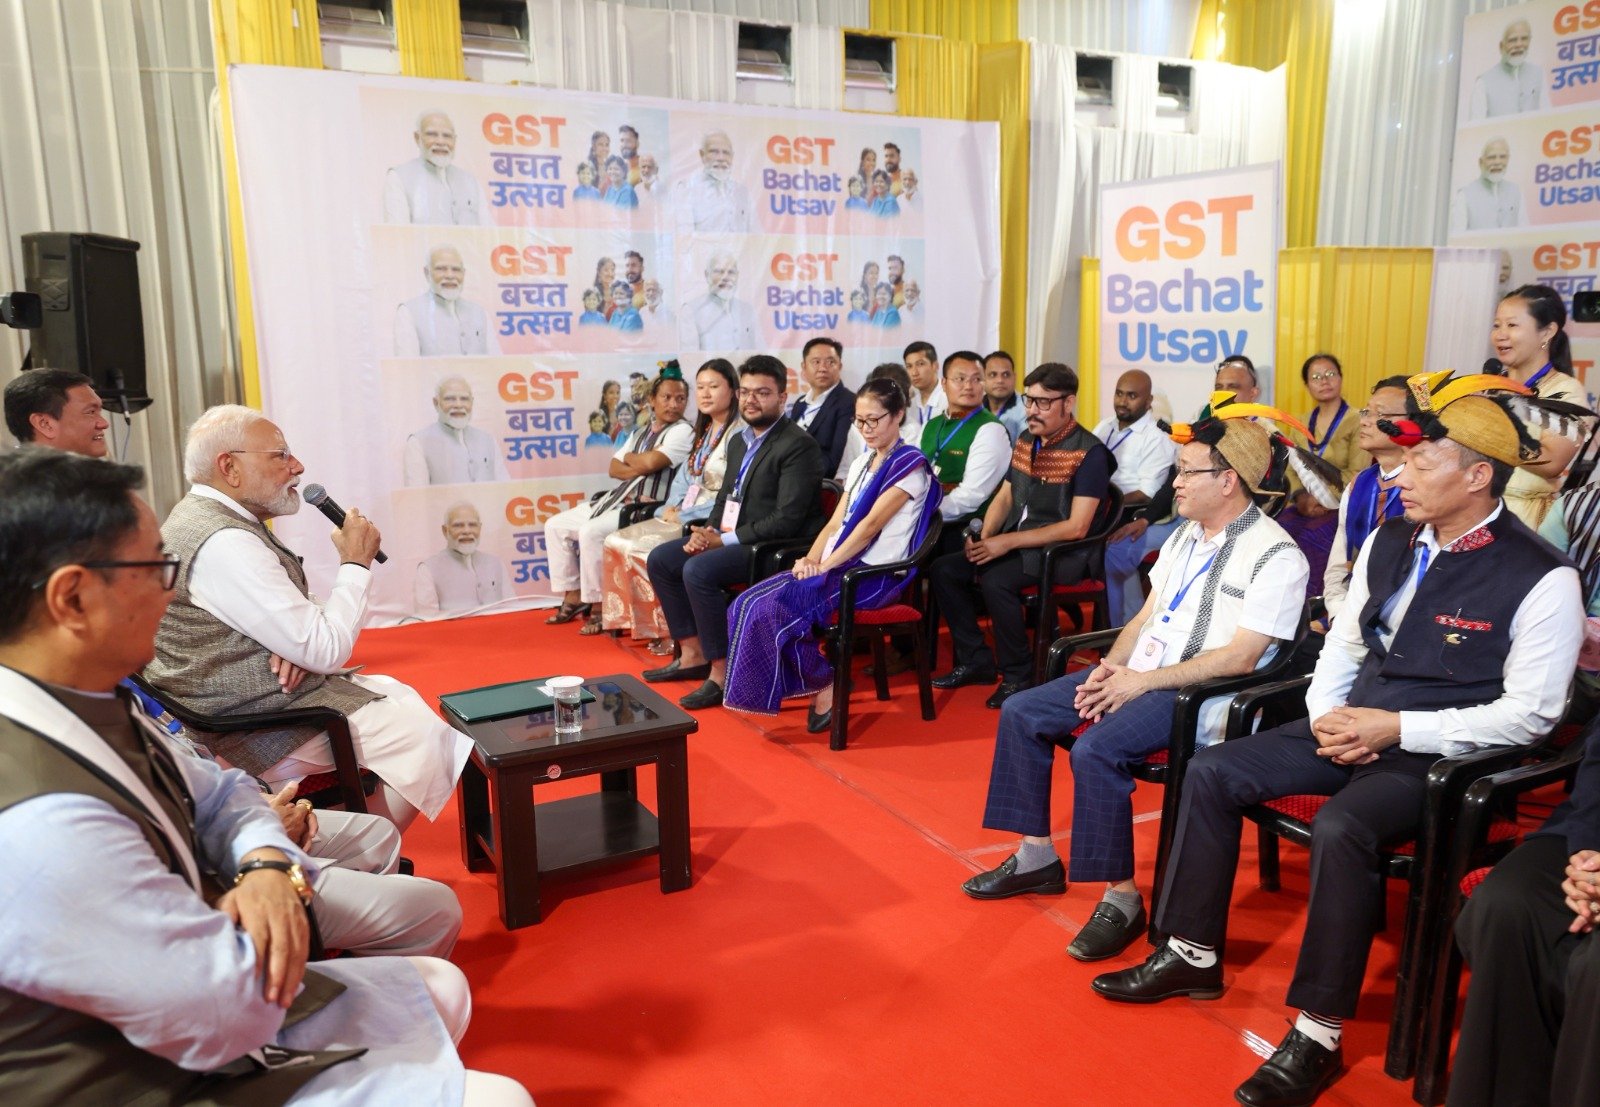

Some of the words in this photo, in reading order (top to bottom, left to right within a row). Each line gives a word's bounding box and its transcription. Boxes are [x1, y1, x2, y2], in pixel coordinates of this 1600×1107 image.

[1556, 33, 1600, 61] बच
[482, 112, 566, 148] GST
[1542, 124, 1600, 158] GS
[767, 135, 835, 166] GST
[490, 152, 561, 180] बचत
[763, 168, 841, 192] Bachat
[489, 181, 566, 209] उत्सव
[770, 194, 836, 216] Utsav
[1115, 195, 1254, 263] GST
[490, 245, 573, 277] GST
[771, 253, 838, 281] GST
[1533, 241, 1600, 271] GST
[498, 283, 568, 308] बचत
[766, 285, 844, 307] Bachat
[1107, 268, 1264, 314] Bachat
[496, 311, 573, 336] उत्सव
[774, 310, 839, 330] Utsav
[1118, 322, 1248, 364] Utsav
[498, 371, 579, 403] GST
[506, 407, 575, 432] बचत
[504, 434, 579, 461] उत्सव
